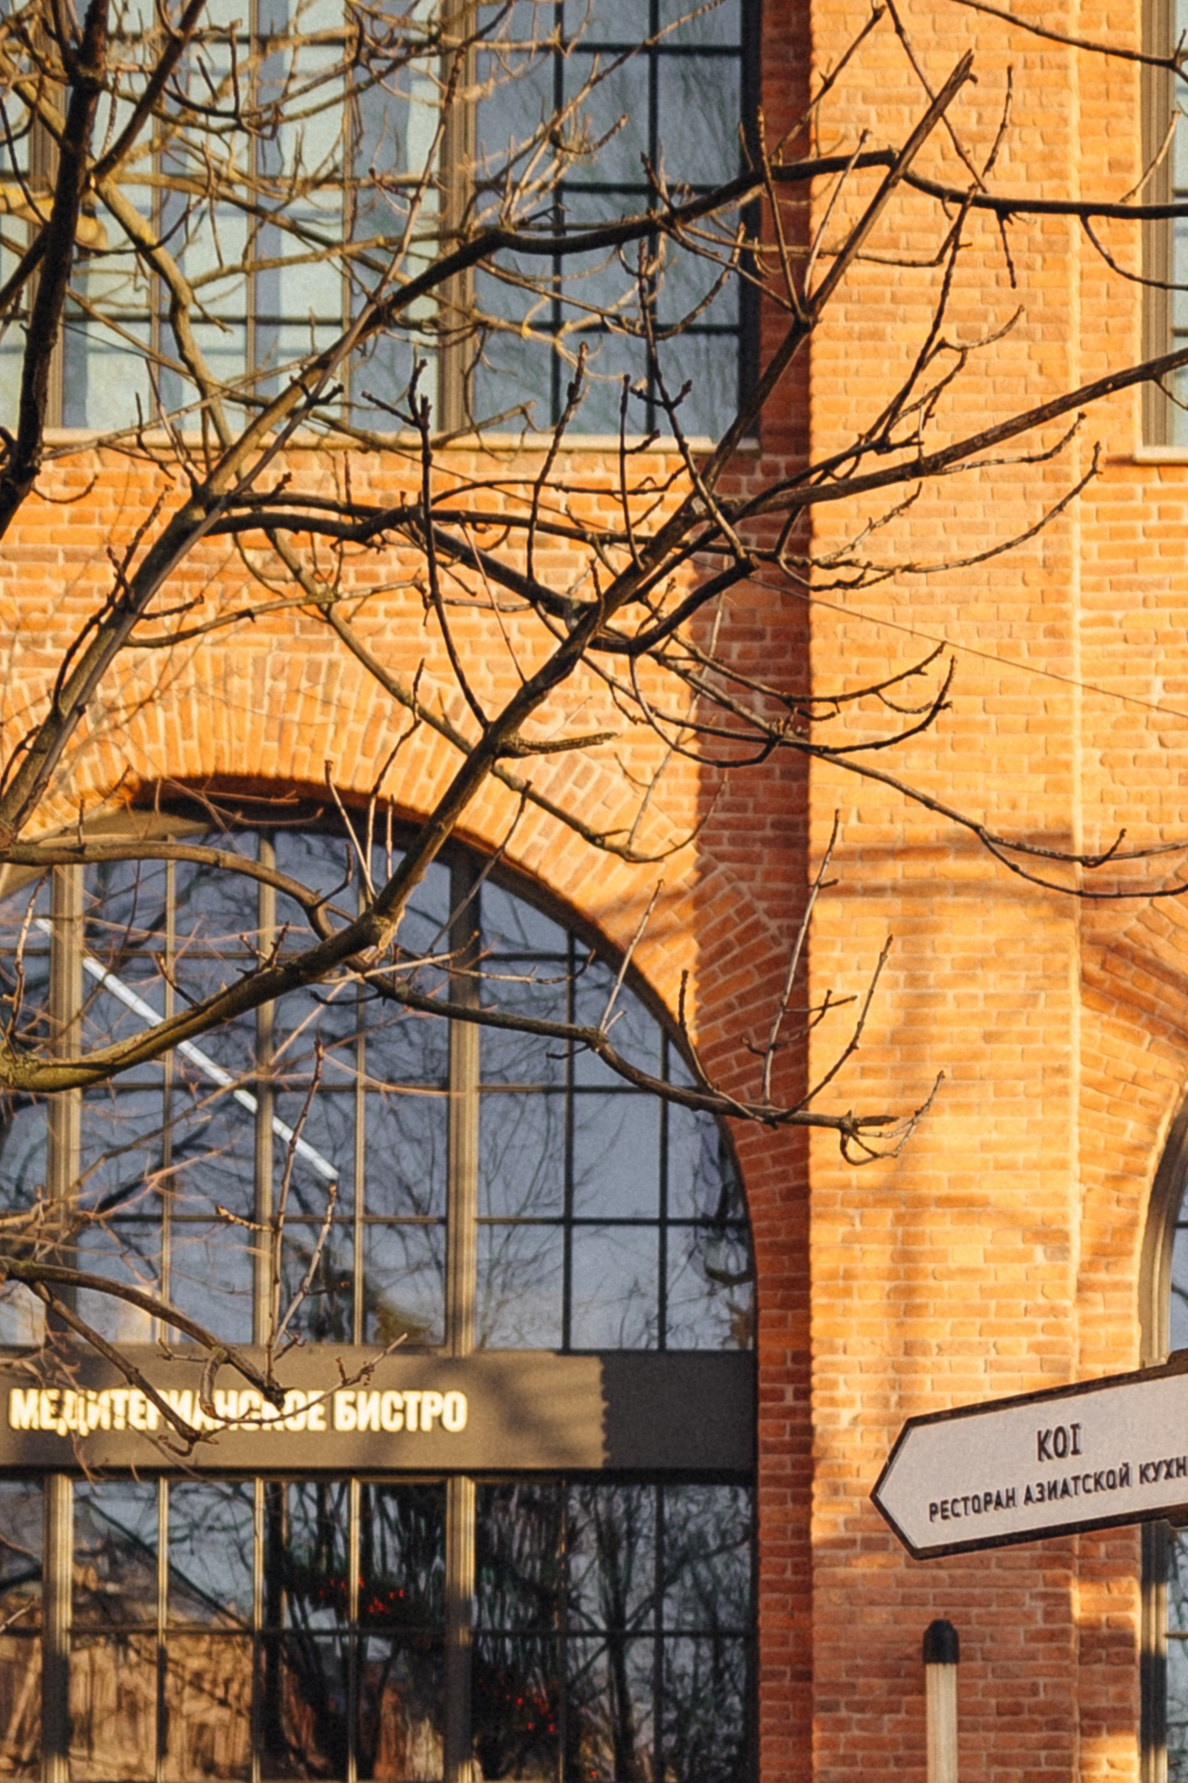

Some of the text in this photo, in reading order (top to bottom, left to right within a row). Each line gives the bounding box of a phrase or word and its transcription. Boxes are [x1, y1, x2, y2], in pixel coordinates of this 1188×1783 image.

[333, 1389, 469, 1433] БИСТРО
[1037, 1423, 1082, 1462] KOI
[928, 1487, 1016, 1523] РЕСТОРАН
[1023, 1462, 1131, 1506] АЗИАТСКОЙ
